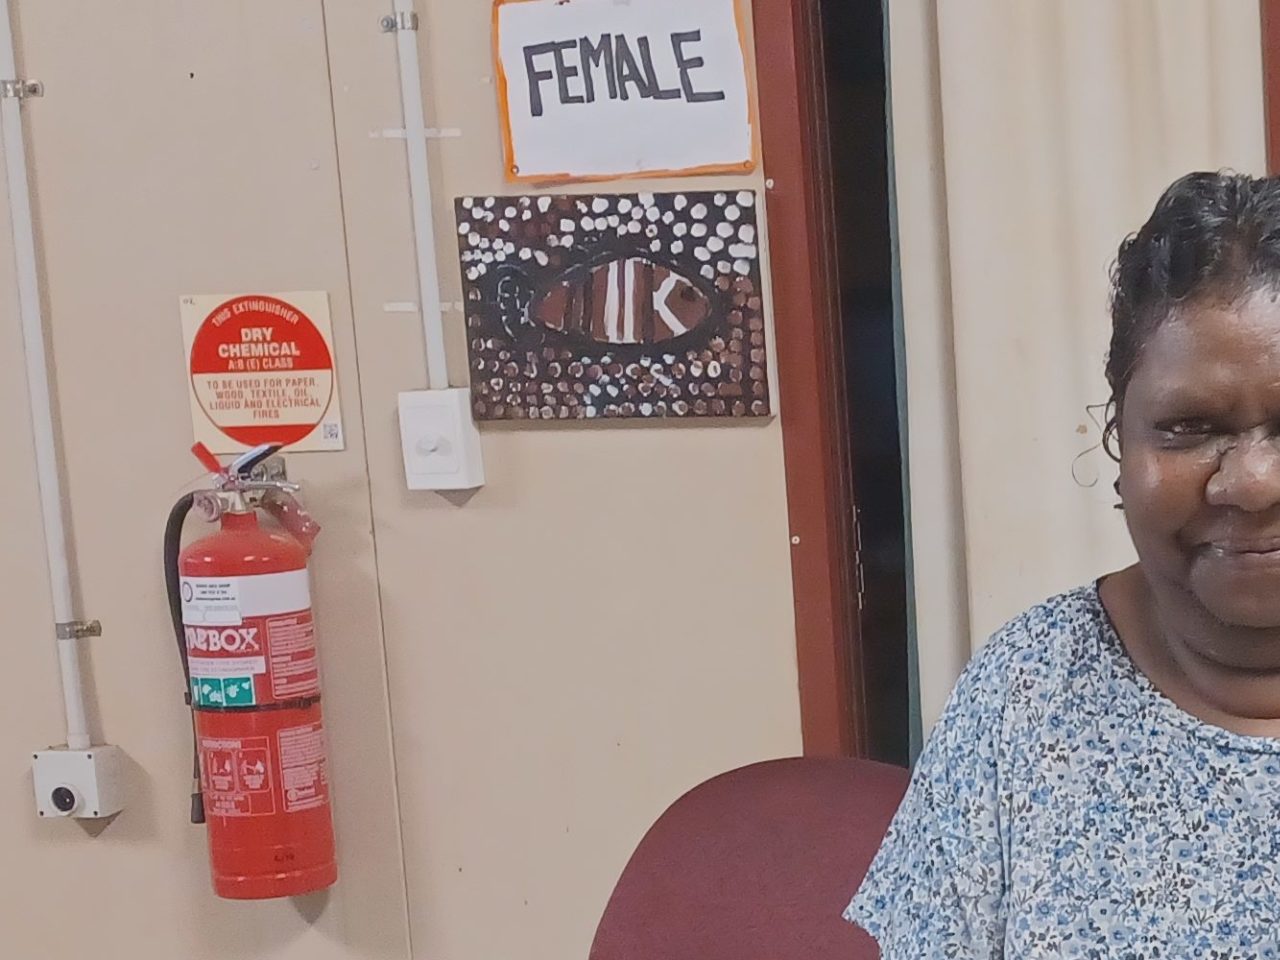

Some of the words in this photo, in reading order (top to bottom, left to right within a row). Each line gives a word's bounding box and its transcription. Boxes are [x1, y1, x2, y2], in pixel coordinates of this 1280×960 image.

[522, 30, 726, 117] FEMALE
[211, 307, 232, 328] THIS
[232, 300, 300, 326] EXTINGUISHER
[240, 327, 274, 342] DRY
[218, 341, 301, 358] CHEMICAL
[262, 357, 294, 369] CLASS
[206, 380, 219, 389] TO
[222, 380, 233, 389] BE
[236, 379, 260, 388] USED
[264, 378, 282, 388] FOR
[209, 400, 241, 411] LIQUID
[244, 399, 262, 410] AND
[266, 397, 321, 409] ELECTRICAL
[253, 410, 280, 420] FIRES
